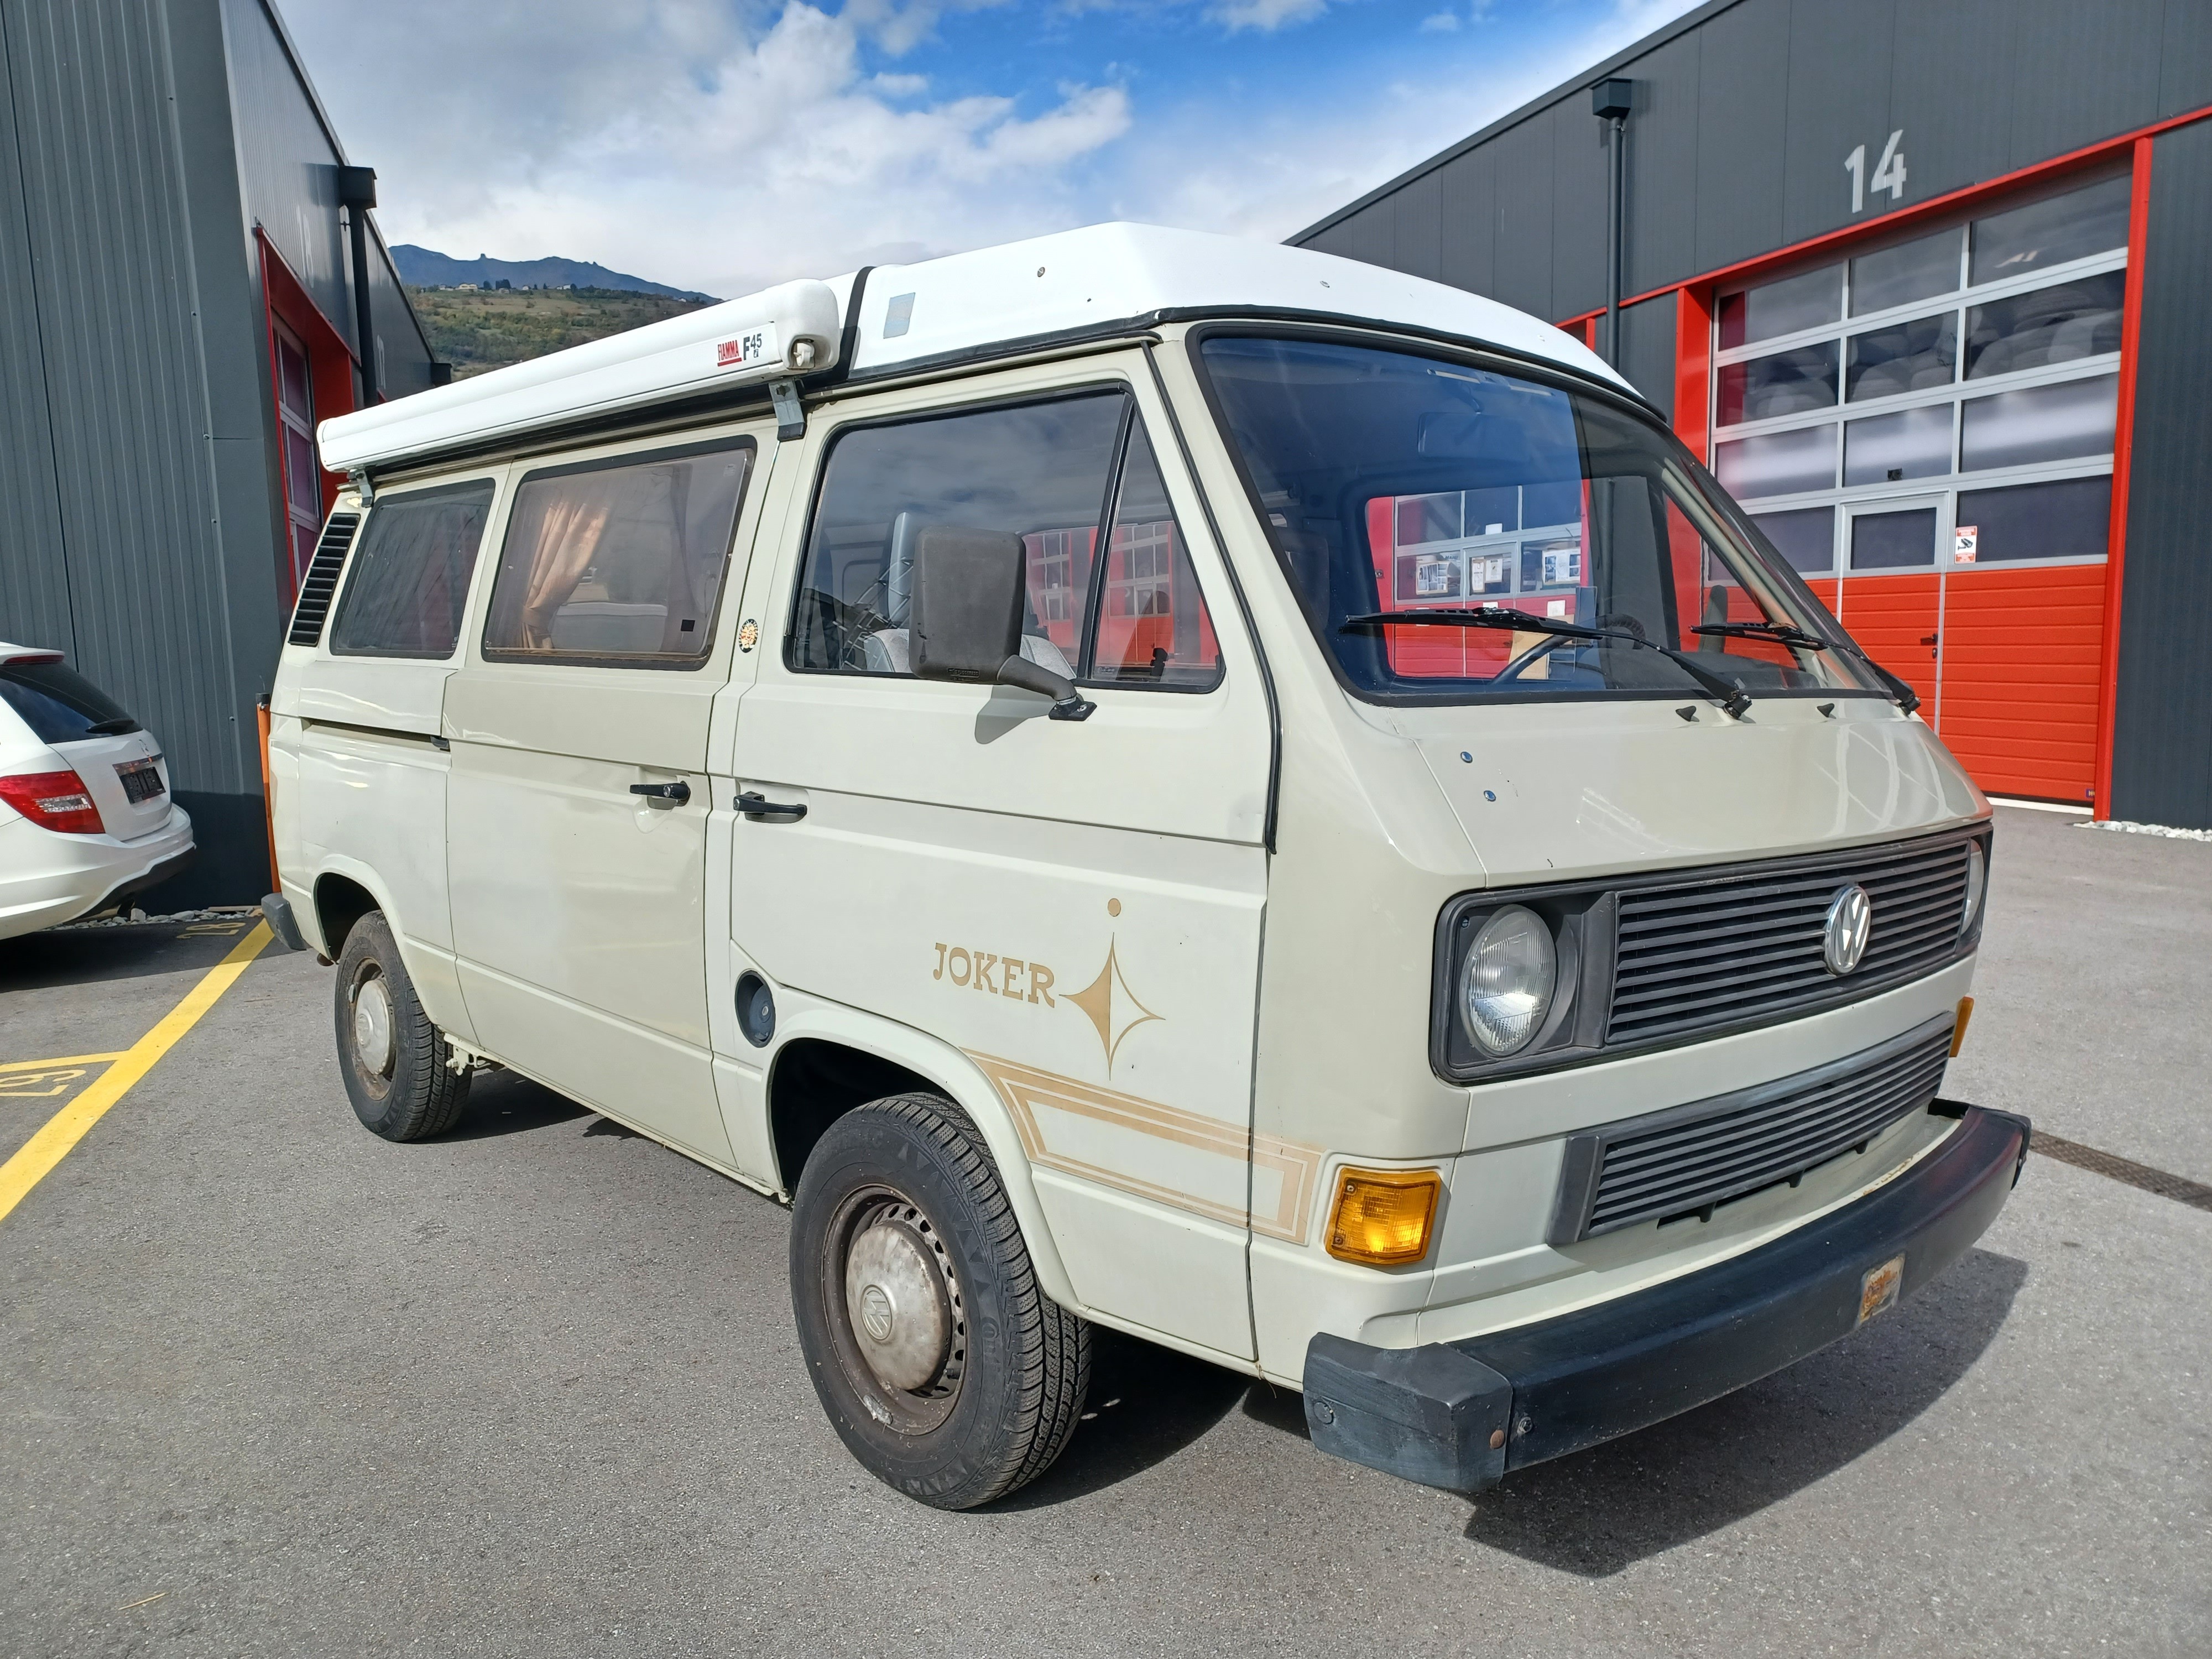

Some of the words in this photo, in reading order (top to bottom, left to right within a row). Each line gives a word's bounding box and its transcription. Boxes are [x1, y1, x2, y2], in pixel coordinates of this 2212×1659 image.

[1844, 129, 1907, 213] 14
[718, 340, 739, 361] FIAMMA
[743, 333, 762, 361] F45
[933, 942, 1055, 1009] JOKER
